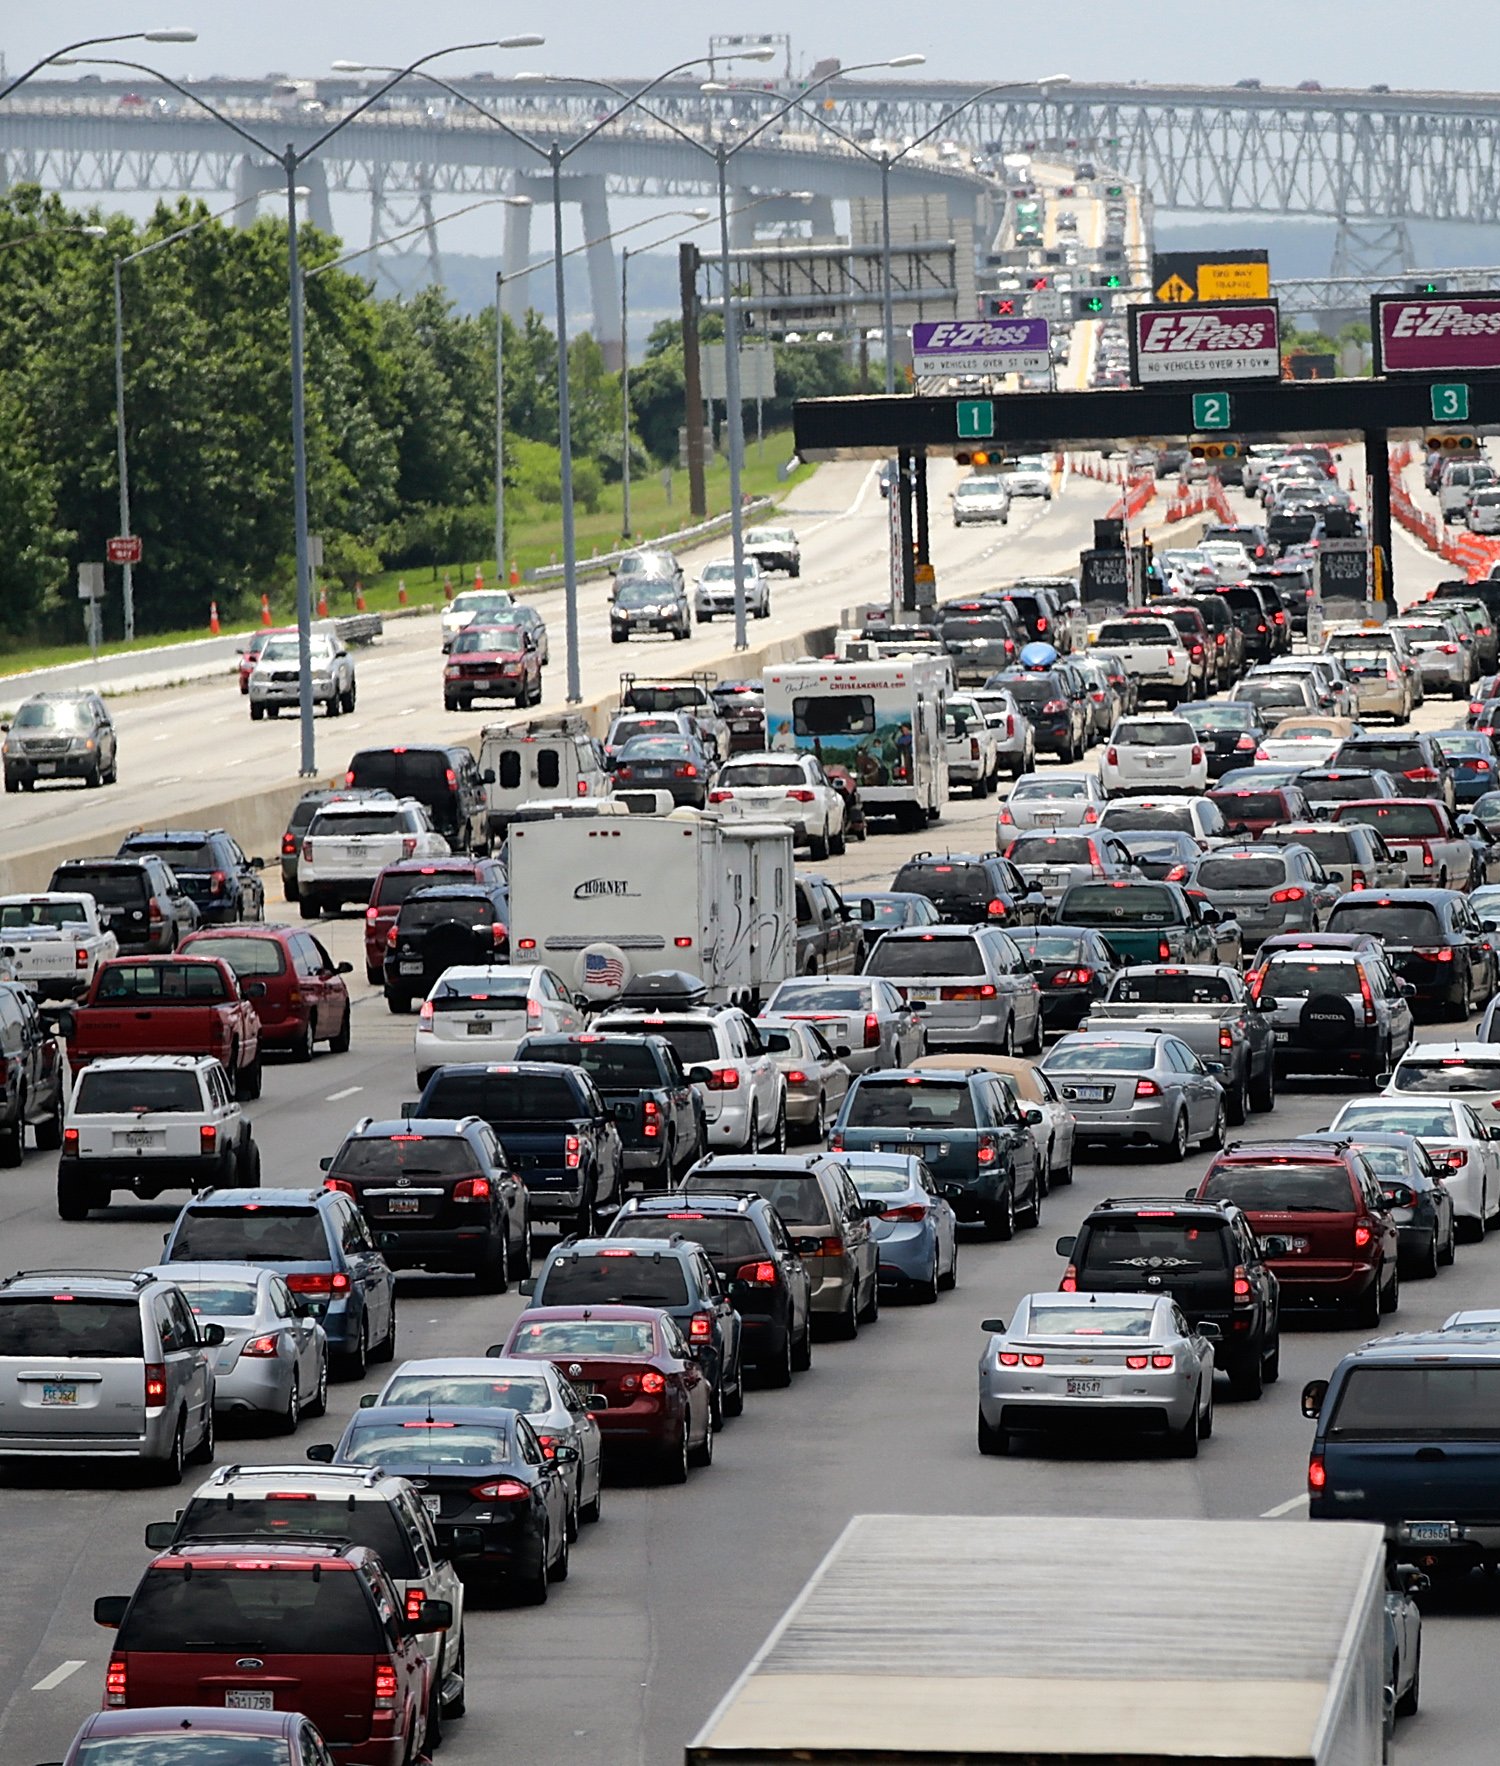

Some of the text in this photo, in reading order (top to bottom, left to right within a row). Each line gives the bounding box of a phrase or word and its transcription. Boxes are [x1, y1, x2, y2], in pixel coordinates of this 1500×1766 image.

[927, 323, 1030, 348] E-ZPass
[1143, 315, 1265, 351] E-ZPass
[923, 362, 934, 370] NO
[941, 360, 977, 369] VEHICLES
[983, 360, 1002, 368] OVER
[1148, 363, 1160, 372] NO
[1164, 361, 1205, 371] VEHICLES
[1209, 360, 1232, 369] OVER
[1251, 358, 1269, 367] GVW
[1204, 399, 1220, 422] 2
[1443, 390, 1458, 414] 3
[970, 407, 981, 431] 1
[585, 880, 628, 894] HORNET
[1310, 1013, 1346, 1021] HONDA
